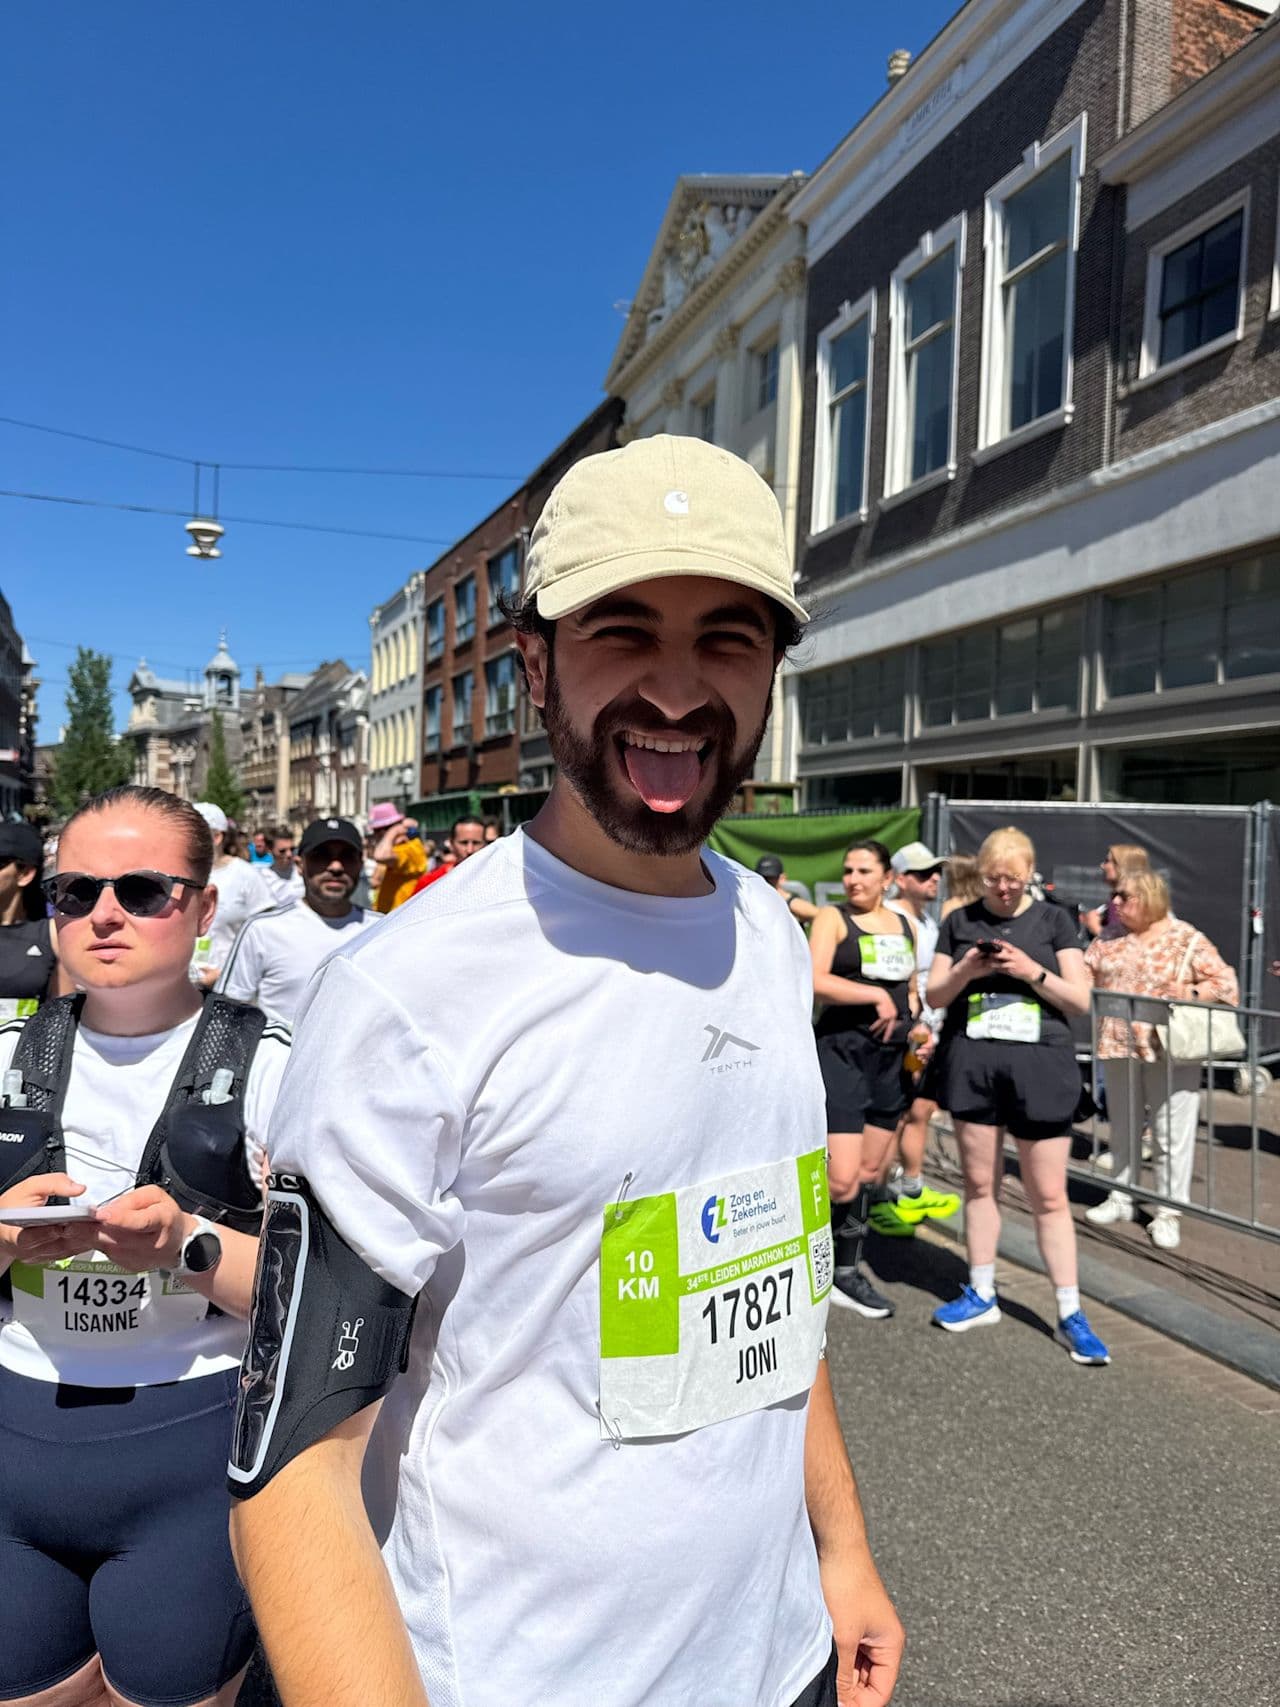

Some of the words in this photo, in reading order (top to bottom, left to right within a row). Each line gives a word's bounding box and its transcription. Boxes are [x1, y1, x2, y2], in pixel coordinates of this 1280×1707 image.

[710, 1059, 752, 1074] TENTH
[730, 1193, 751, 1208] Zorg
[753, 1190, 765, 1200] en
[731, 1198, 777, 1223] Zekerheid
[813, 1183, 822, 1216] F
[625, 1250, 654, 1274] 10
[710, 1263, 740, 1284] LEIDEN
[741, 1247, 784, 1273] MARATHON
[57, 1276, 147, 1307] 14334
[618, 1277, 659, 1300] KM
[702, 1268, 794, 1344] 17827
[64, 1307, 139, 1332] LISANNE
[736, 1337, 778, 1384] JONI
